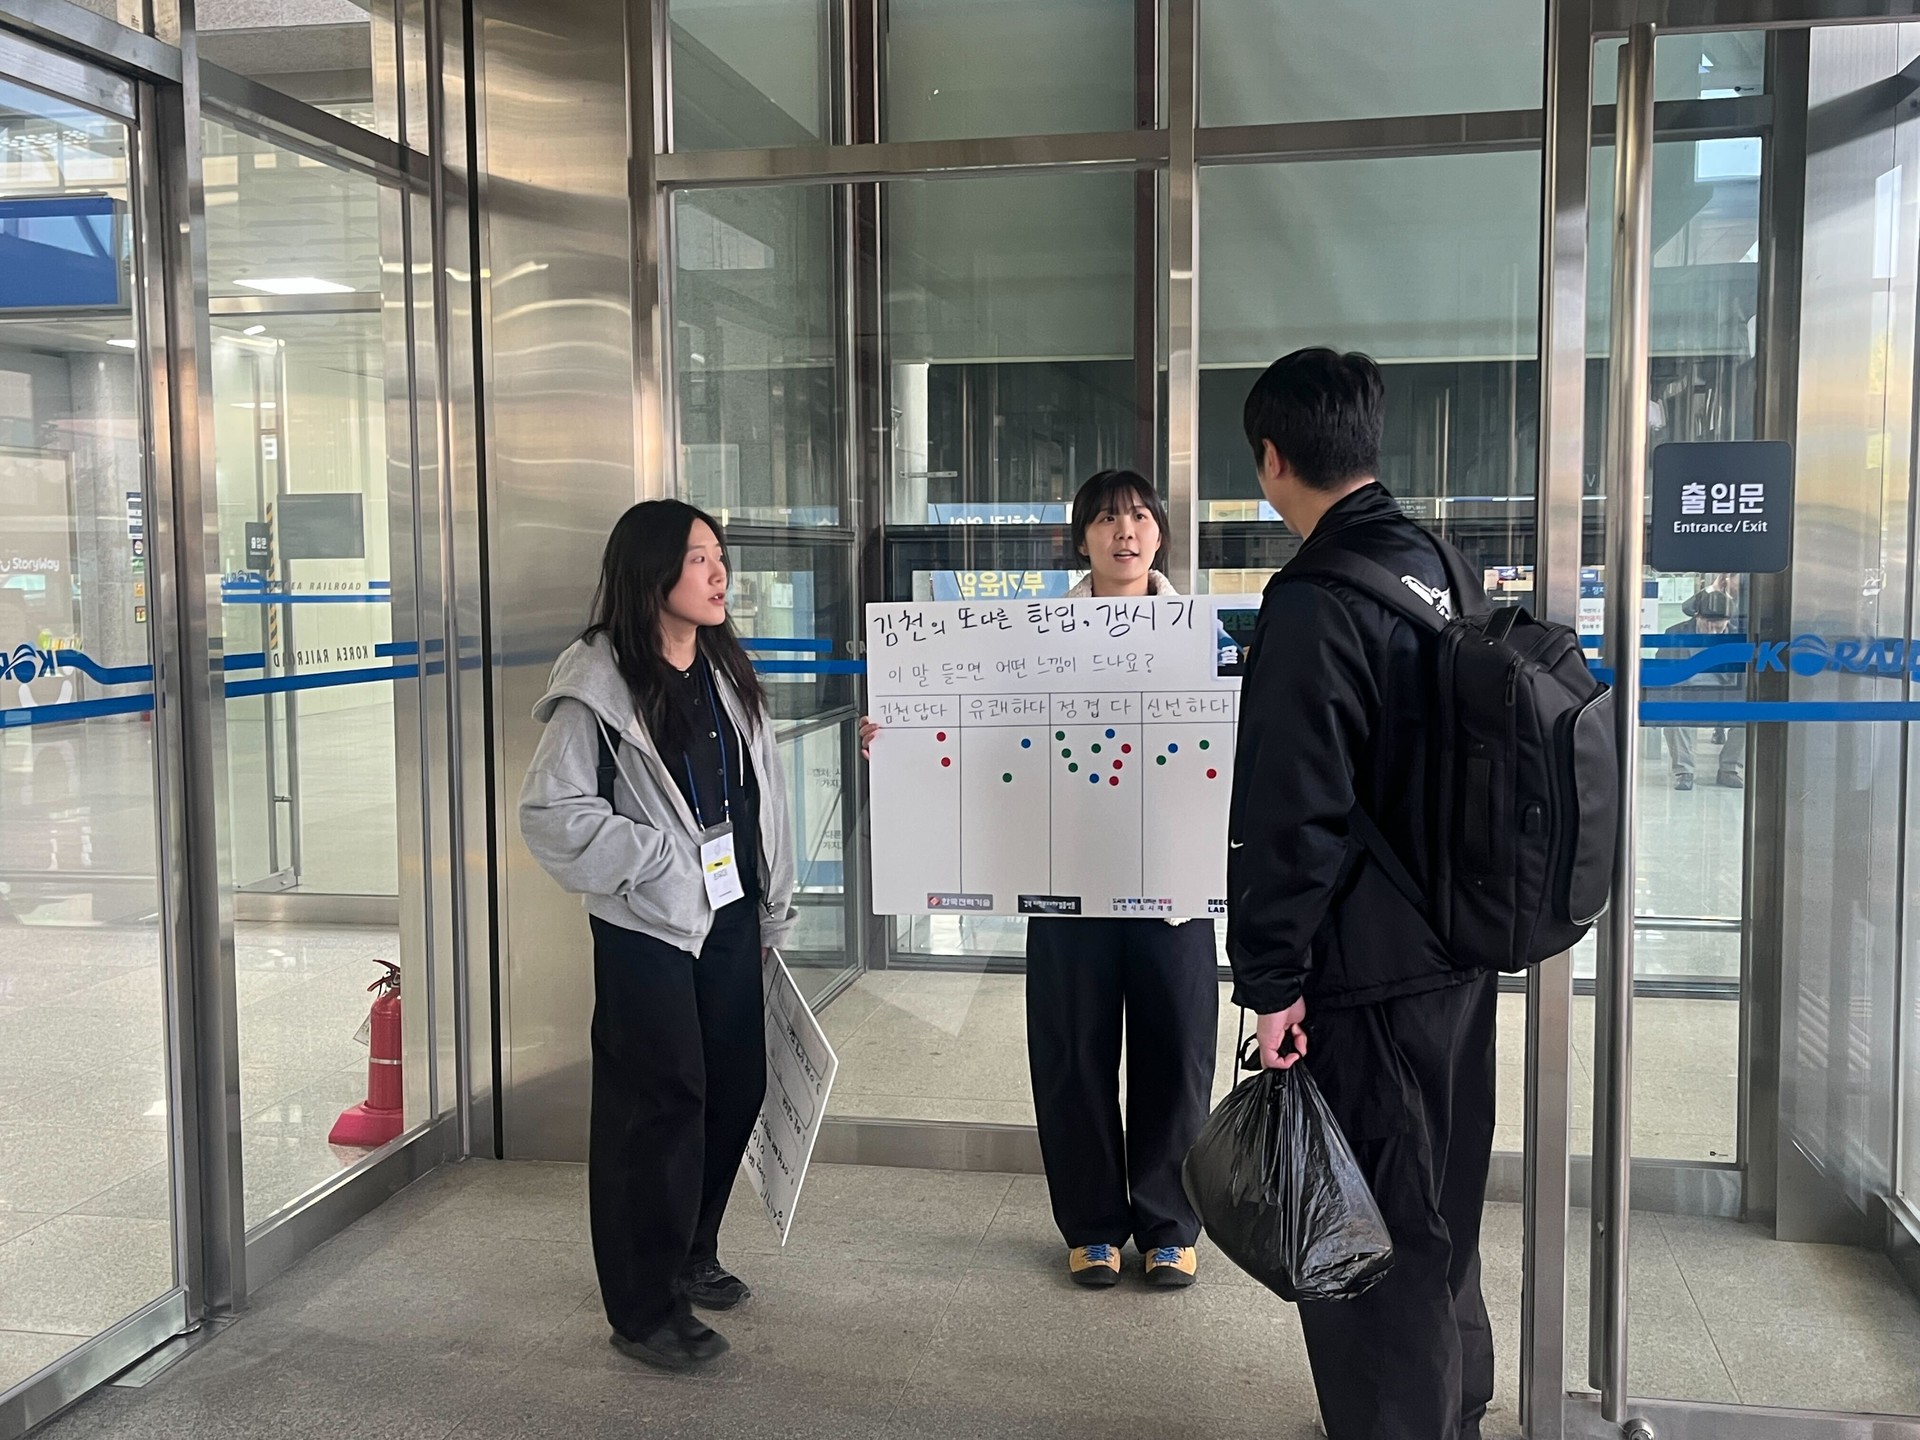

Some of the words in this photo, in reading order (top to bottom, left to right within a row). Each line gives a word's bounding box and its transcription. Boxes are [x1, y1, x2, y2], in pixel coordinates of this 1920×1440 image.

[1681, 482, 1765, 515] 출입문
[1673, 520, 1768, 533] Entrance/Exit
[309, 582, 362, 591] RAILROAD
[873, 609, 946, 647] 김천의
[1095, 600, 1194, 638] 갱시기
[888, 665, 902, 683] 이
[912, 663, 929, 687] 말
[941, 661, 985, 685] 들으면
[995, 657, 1028, 679] 어떤
[1037, 655, 1076, 674] 느낌이
[1092, 652, 1155, 673] 드나요?
[879, 701, 948, 725] 김천답다
[968, 698, 1046, 721] 유쾌하다
[1057, 698, 1132, 719] 정겹다
[1147, 697, 1230, 719] 신선하다
